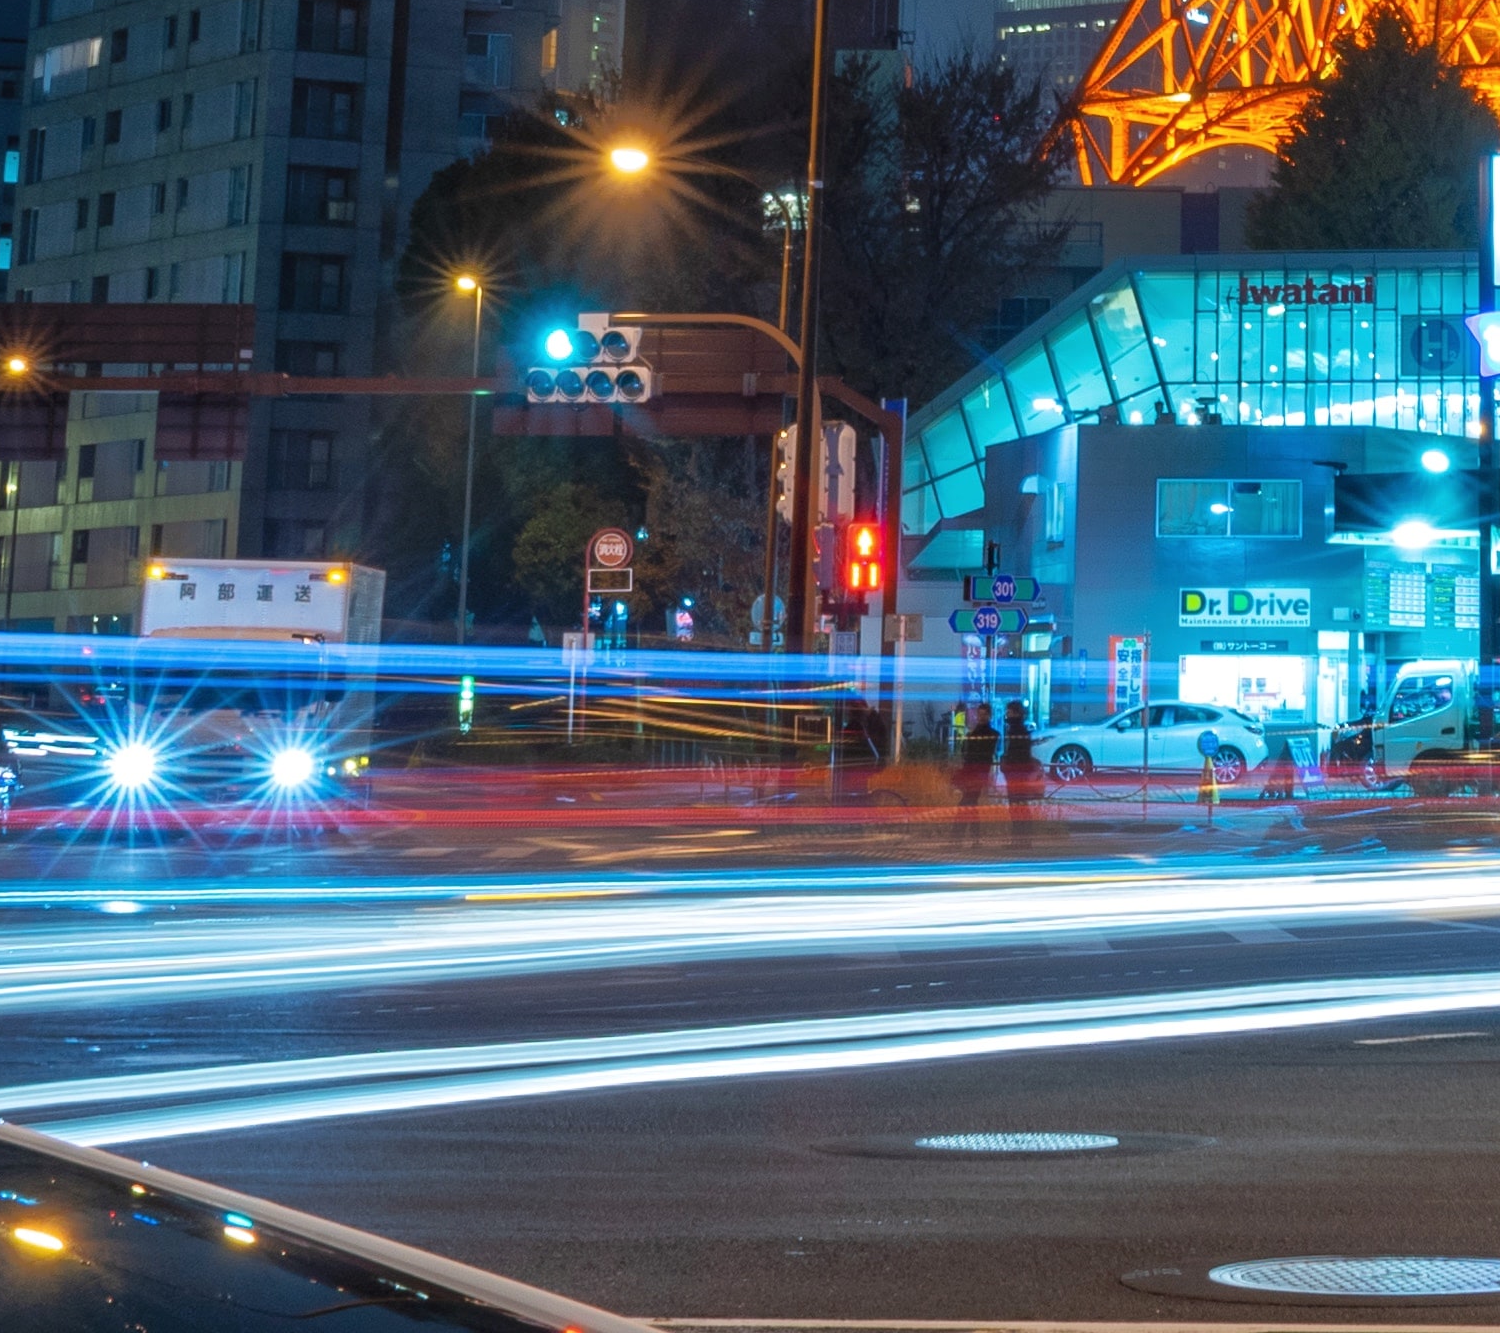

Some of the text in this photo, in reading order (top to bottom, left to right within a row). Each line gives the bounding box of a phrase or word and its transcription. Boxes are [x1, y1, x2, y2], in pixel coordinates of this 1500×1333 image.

[1238, 276, 1374, 305] Iwatani
[179, 582, 312, 603] 阿部運送
[994, 582, 1014, 597] 301
[1181, 590, 1309, 616] Dr. Drive
[977, 614, 998, 629] 319
[1181, 617, 1238, 625] Maintenance
[1251, 617, 1309, 625] Refreshment
